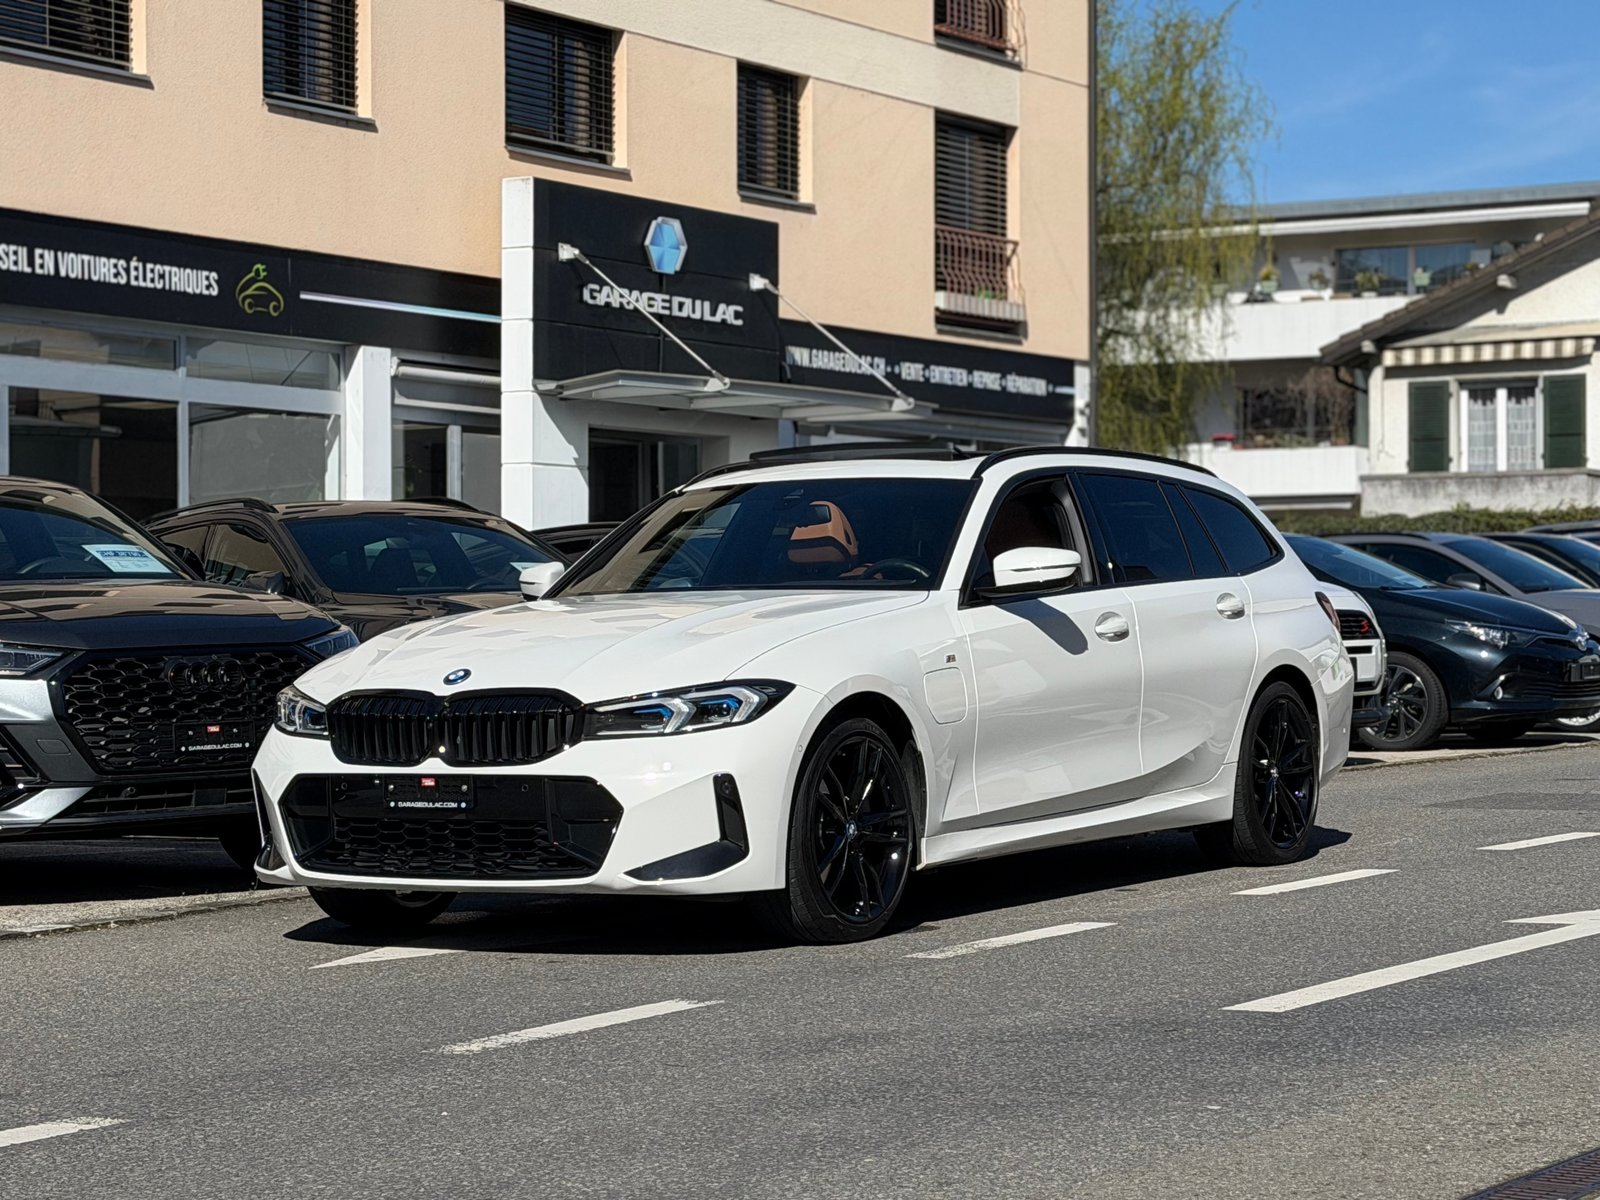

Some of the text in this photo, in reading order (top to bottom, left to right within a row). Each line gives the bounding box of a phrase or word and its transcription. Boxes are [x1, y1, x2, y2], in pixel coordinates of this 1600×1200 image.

[34, 247, 54, 276] EN
[57, 250, 127, 285] VOITURES
[130, 256, 219, 296] ÉLECTRIQUES
[582, 283, 744, 326] GARAGE DU LAC
